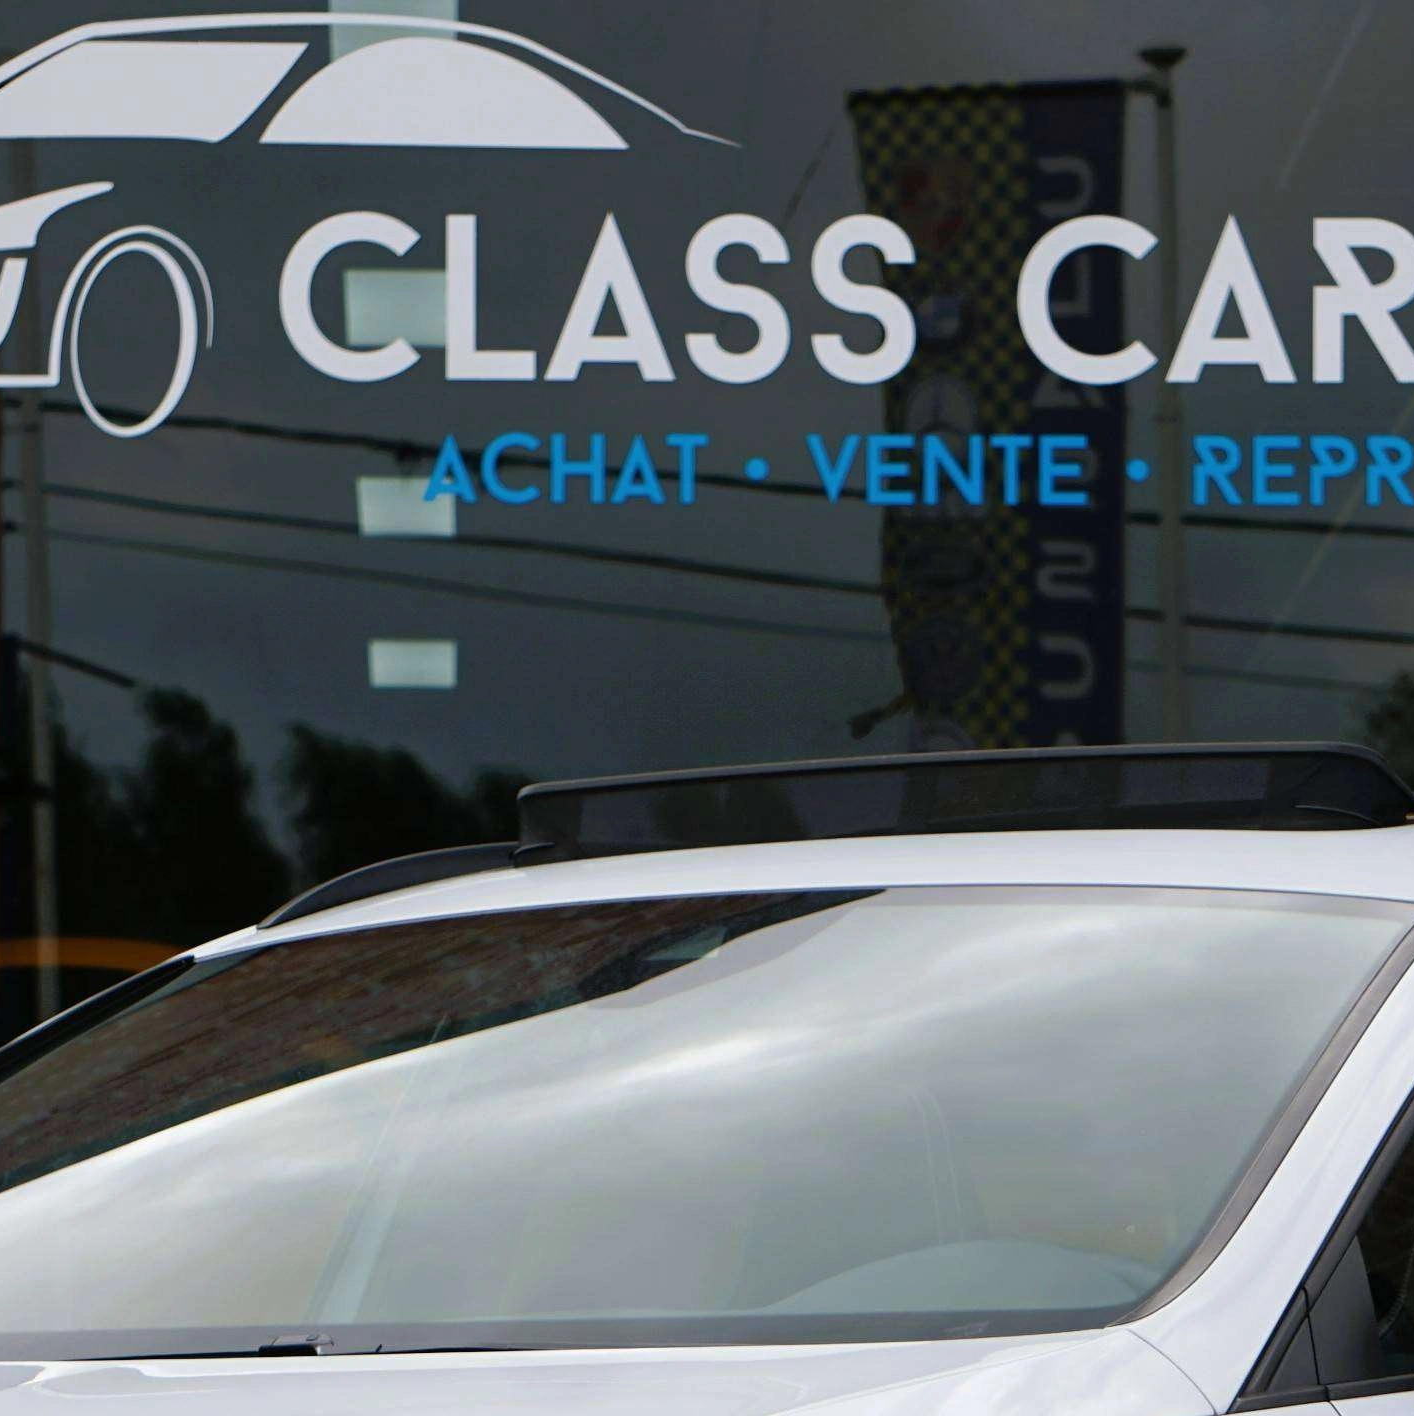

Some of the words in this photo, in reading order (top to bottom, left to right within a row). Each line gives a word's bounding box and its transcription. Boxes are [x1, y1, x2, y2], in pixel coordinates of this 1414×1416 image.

[279, 211, 915, 384] CLASS
[422, 431, 710, 506] ACHAT
[806, 433, 1089, 506] VENTE
